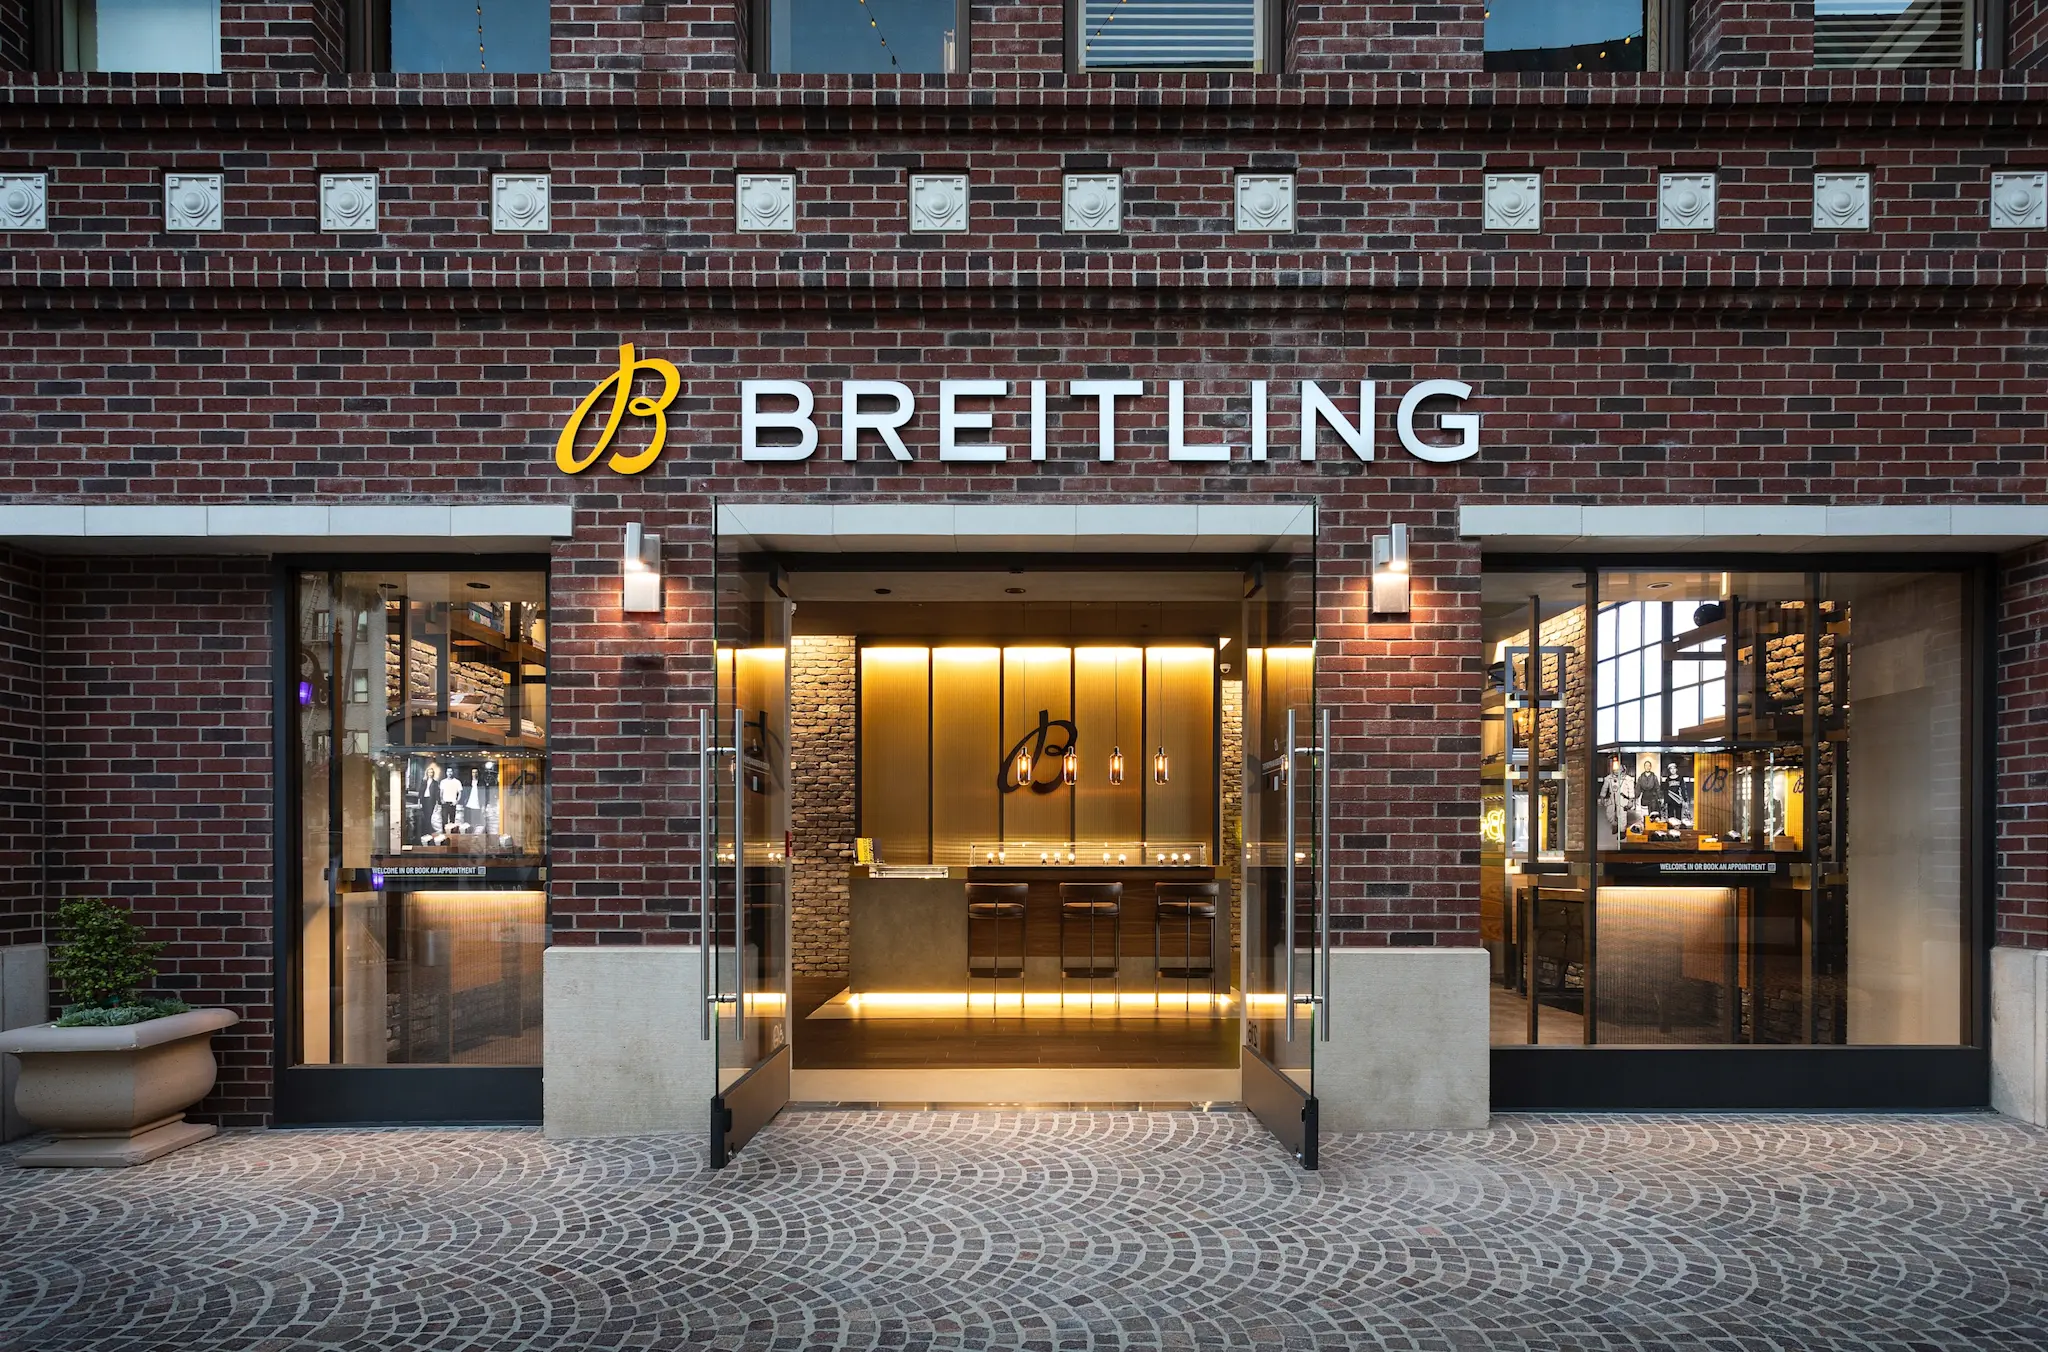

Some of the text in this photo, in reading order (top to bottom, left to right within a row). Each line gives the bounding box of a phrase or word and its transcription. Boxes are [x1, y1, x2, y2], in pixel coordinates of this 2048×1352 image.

[742, 379, 1480, 463] BREITLING
[372, 866, 476, 874] WELCOME IN OR BOOK AN APPOINTMENT
[1660, 863, 1766, 871] WELCOME IN OR BOOK AN APPOINTMENT
